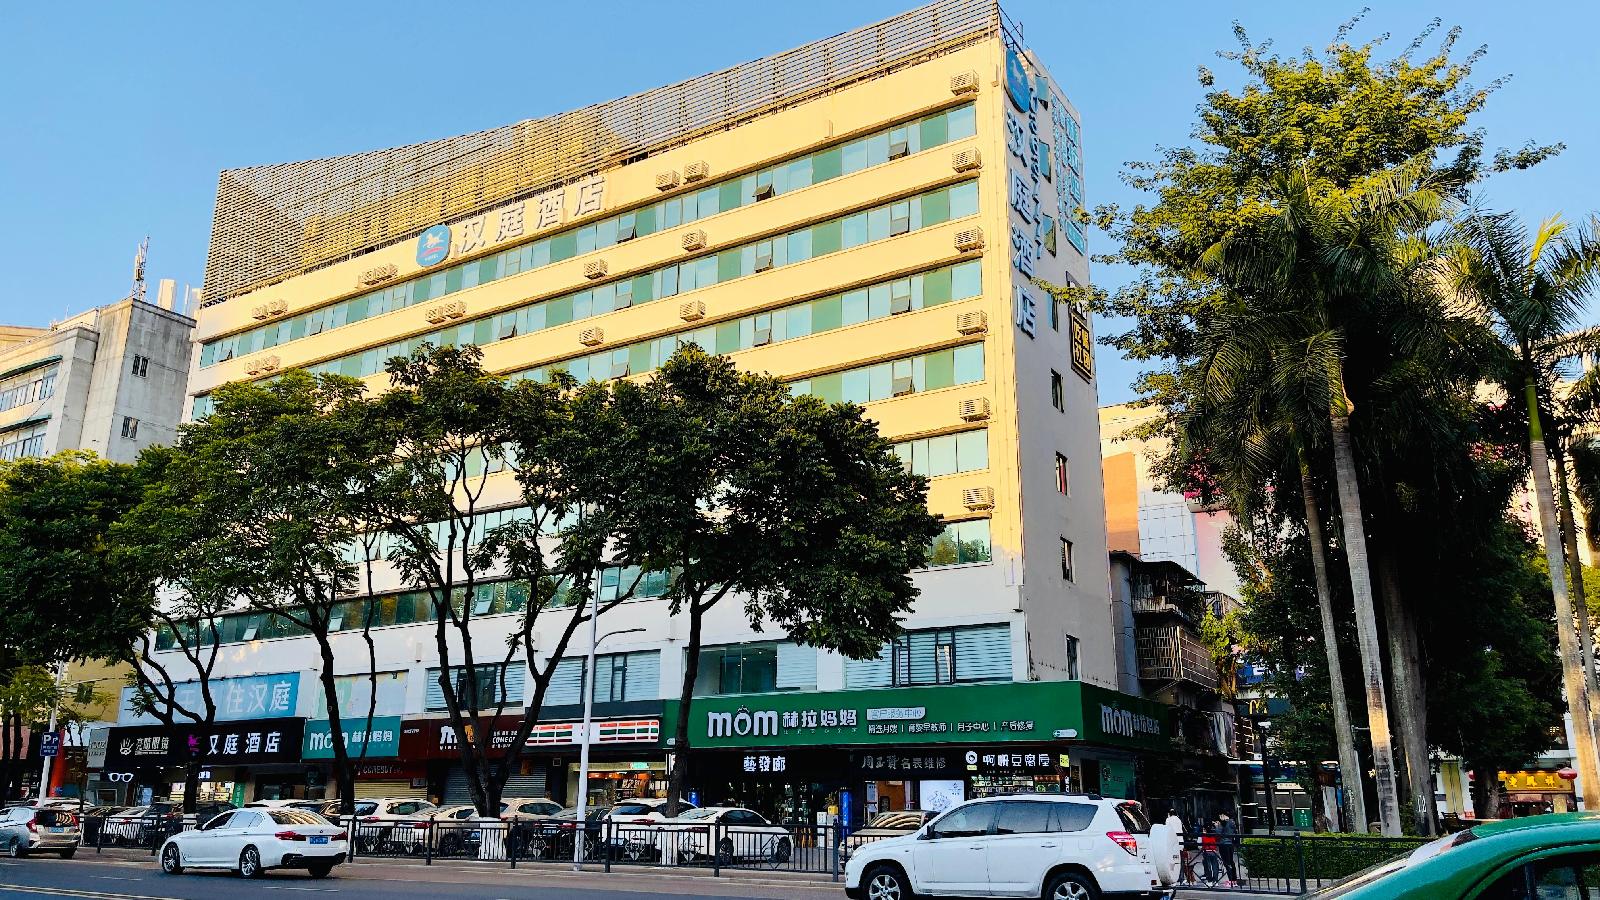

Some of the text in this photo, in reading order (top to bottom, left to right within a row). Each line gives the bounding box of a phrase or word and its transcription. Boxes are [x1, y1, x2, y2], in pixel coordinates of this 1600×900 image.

[458, 175, 606, 254] 汉庭酒店
[1007, 108, 1037, 341] 汉庭酒店
[226, 680, 292, 714] 住汉庭
